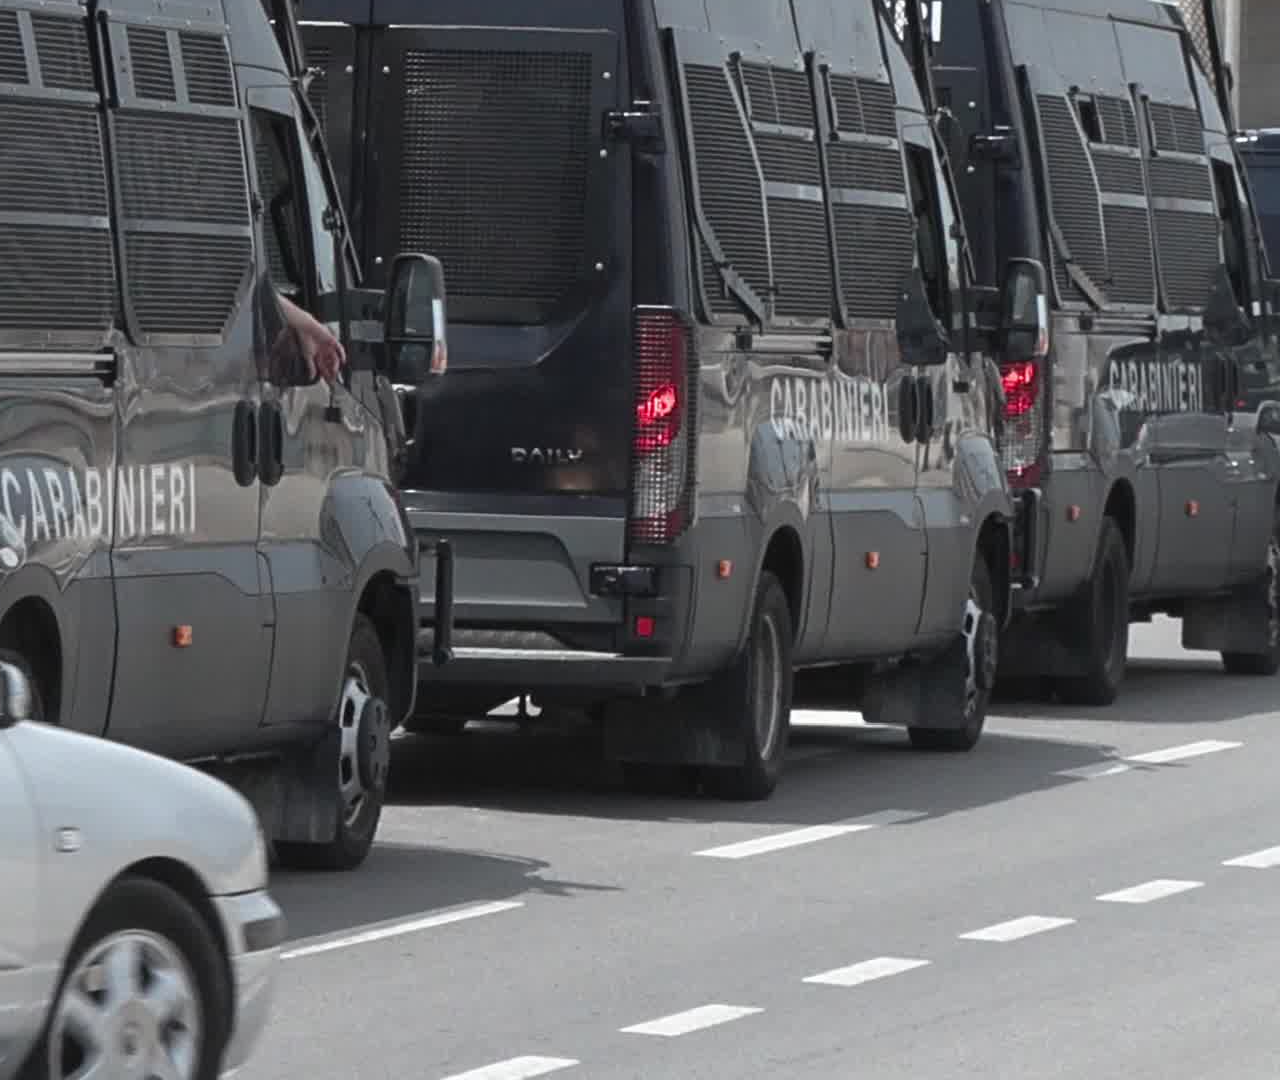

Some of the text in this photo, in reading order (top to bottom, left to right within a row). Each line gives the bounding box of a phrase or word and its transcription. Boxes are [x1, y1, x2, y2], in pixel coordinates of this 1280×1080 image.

[770, 377, 889, 441] CARABINIERI
[1110, 360, 1203, 411] CARABINIERI
[511, 447, 584, 464] DAILY
[1, 463, 195, 544] CARABINIERI
